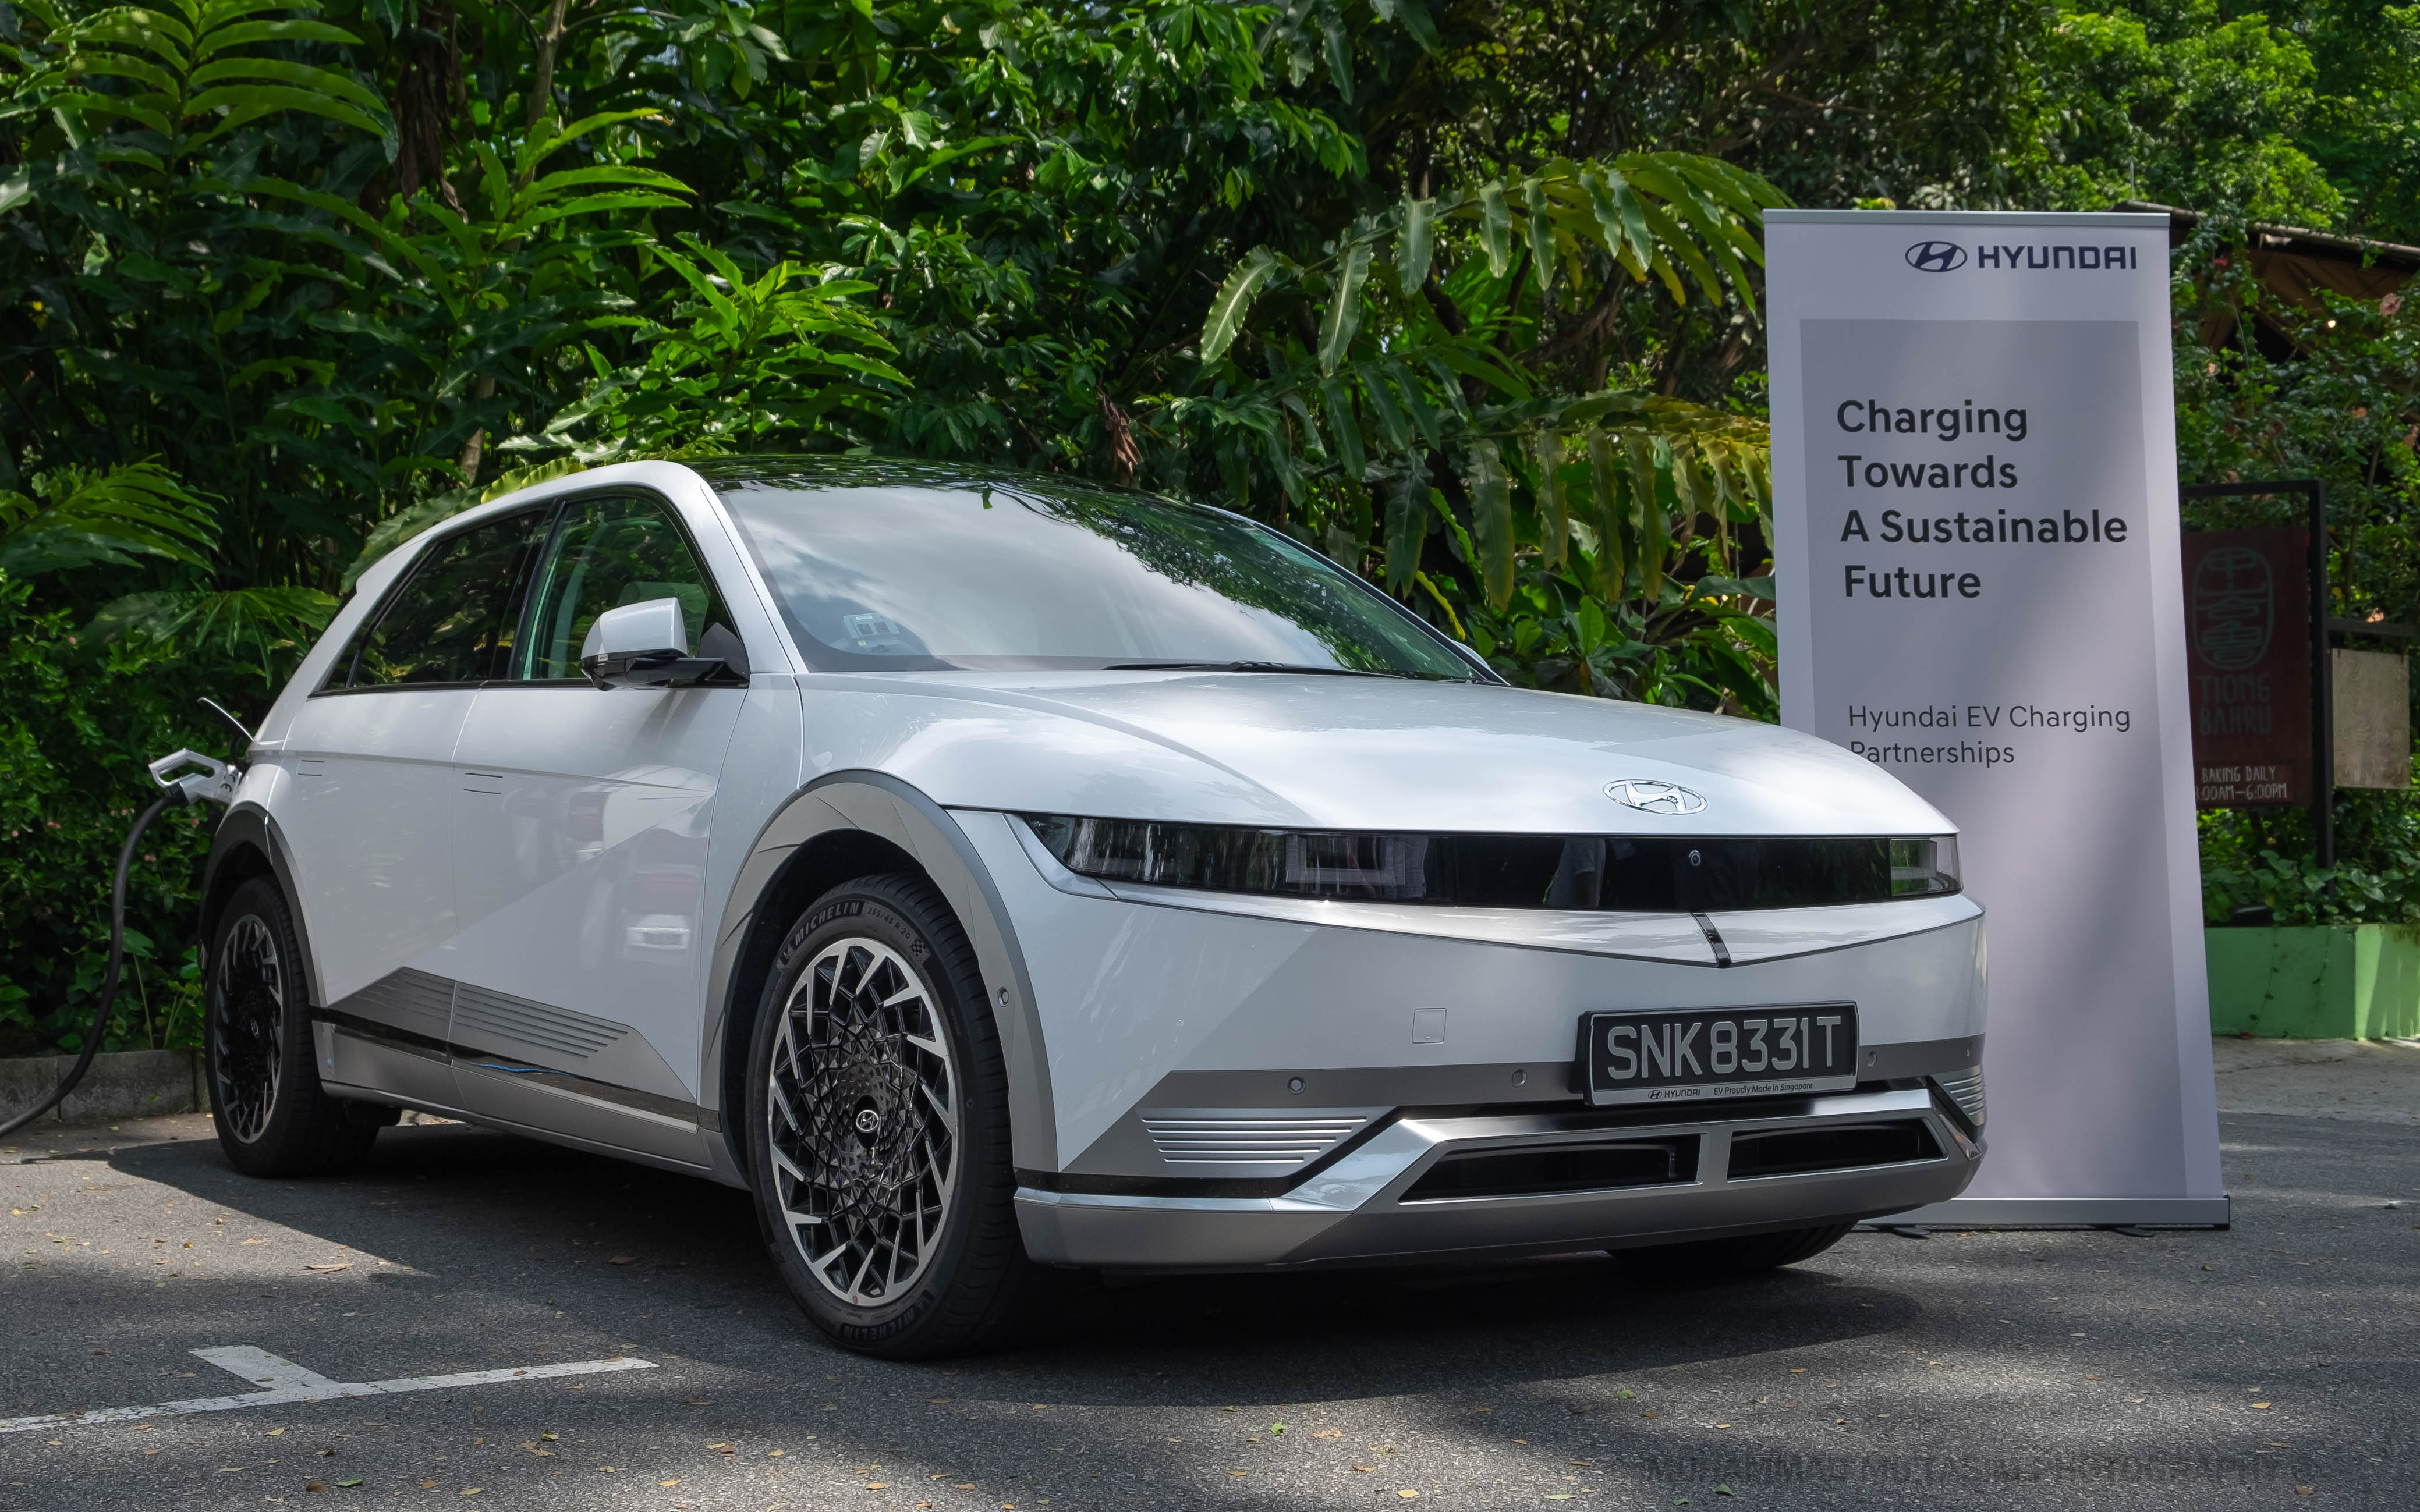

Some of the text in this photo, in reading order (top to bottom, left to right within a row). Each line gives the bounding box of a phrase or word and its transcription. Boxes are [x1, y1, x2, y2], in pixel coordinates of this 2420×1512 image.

[1978, 245, 2137, 269] HYUNDAI
[1837, 399, 2028, 442] Charging
[1837, 455, 2018, 488] Towards
[1840, 509, 2128, 544] A Sustainable
[1844, 565, 1982, 598] Future
[2198, 672, 2272, 704] TIONG
[1849, 704, 2131, 733] Hyundai EV Charging
[2199, 705, 2272, 736] BAHRU
[1851, 741, 2015, 768] Partnerships
[2201, 765, 2276, 783] BAKING DAILY
[795, 902, 911, 947] MICHELIN 255/45 R 20
[1664, 1088, 1700, 1098] HYUNDAI
[1713, 1087, 1724, 1095] EV
[1724, 1085, 1751, 1096] Proudly
[1752, 1084, 1771, 1093] Made
[1780, 1082, 1813, 1093] Singapore
[844, 1307, 915, 1339] MICHELIN
